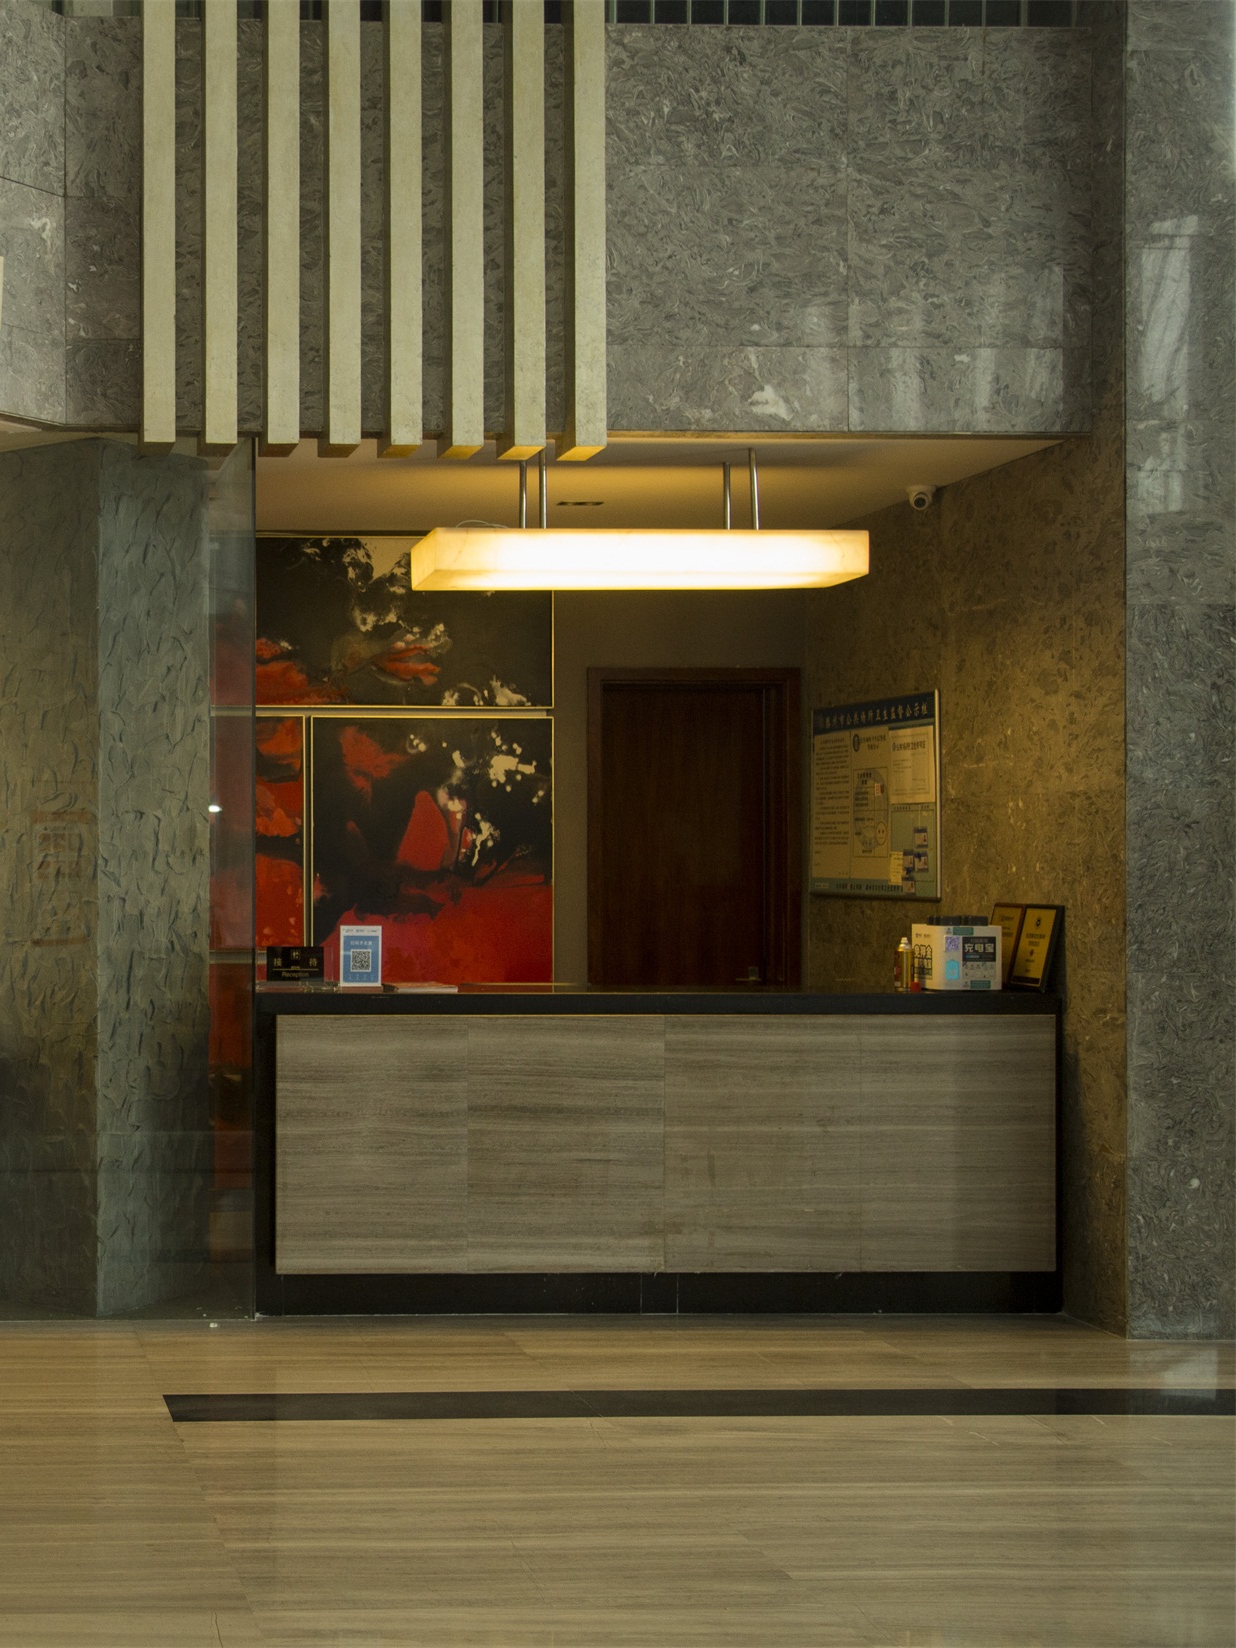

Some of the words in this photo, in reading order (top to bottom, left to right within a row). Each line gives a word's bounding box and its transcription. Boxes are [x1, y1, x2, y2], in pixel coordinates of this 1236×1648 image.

[964, 943, 994, 953] 充电宝
[273, 957, 283, 967] 接
[309, 957, 318, 967] 待
[281, 971, 310, 979] Reception
